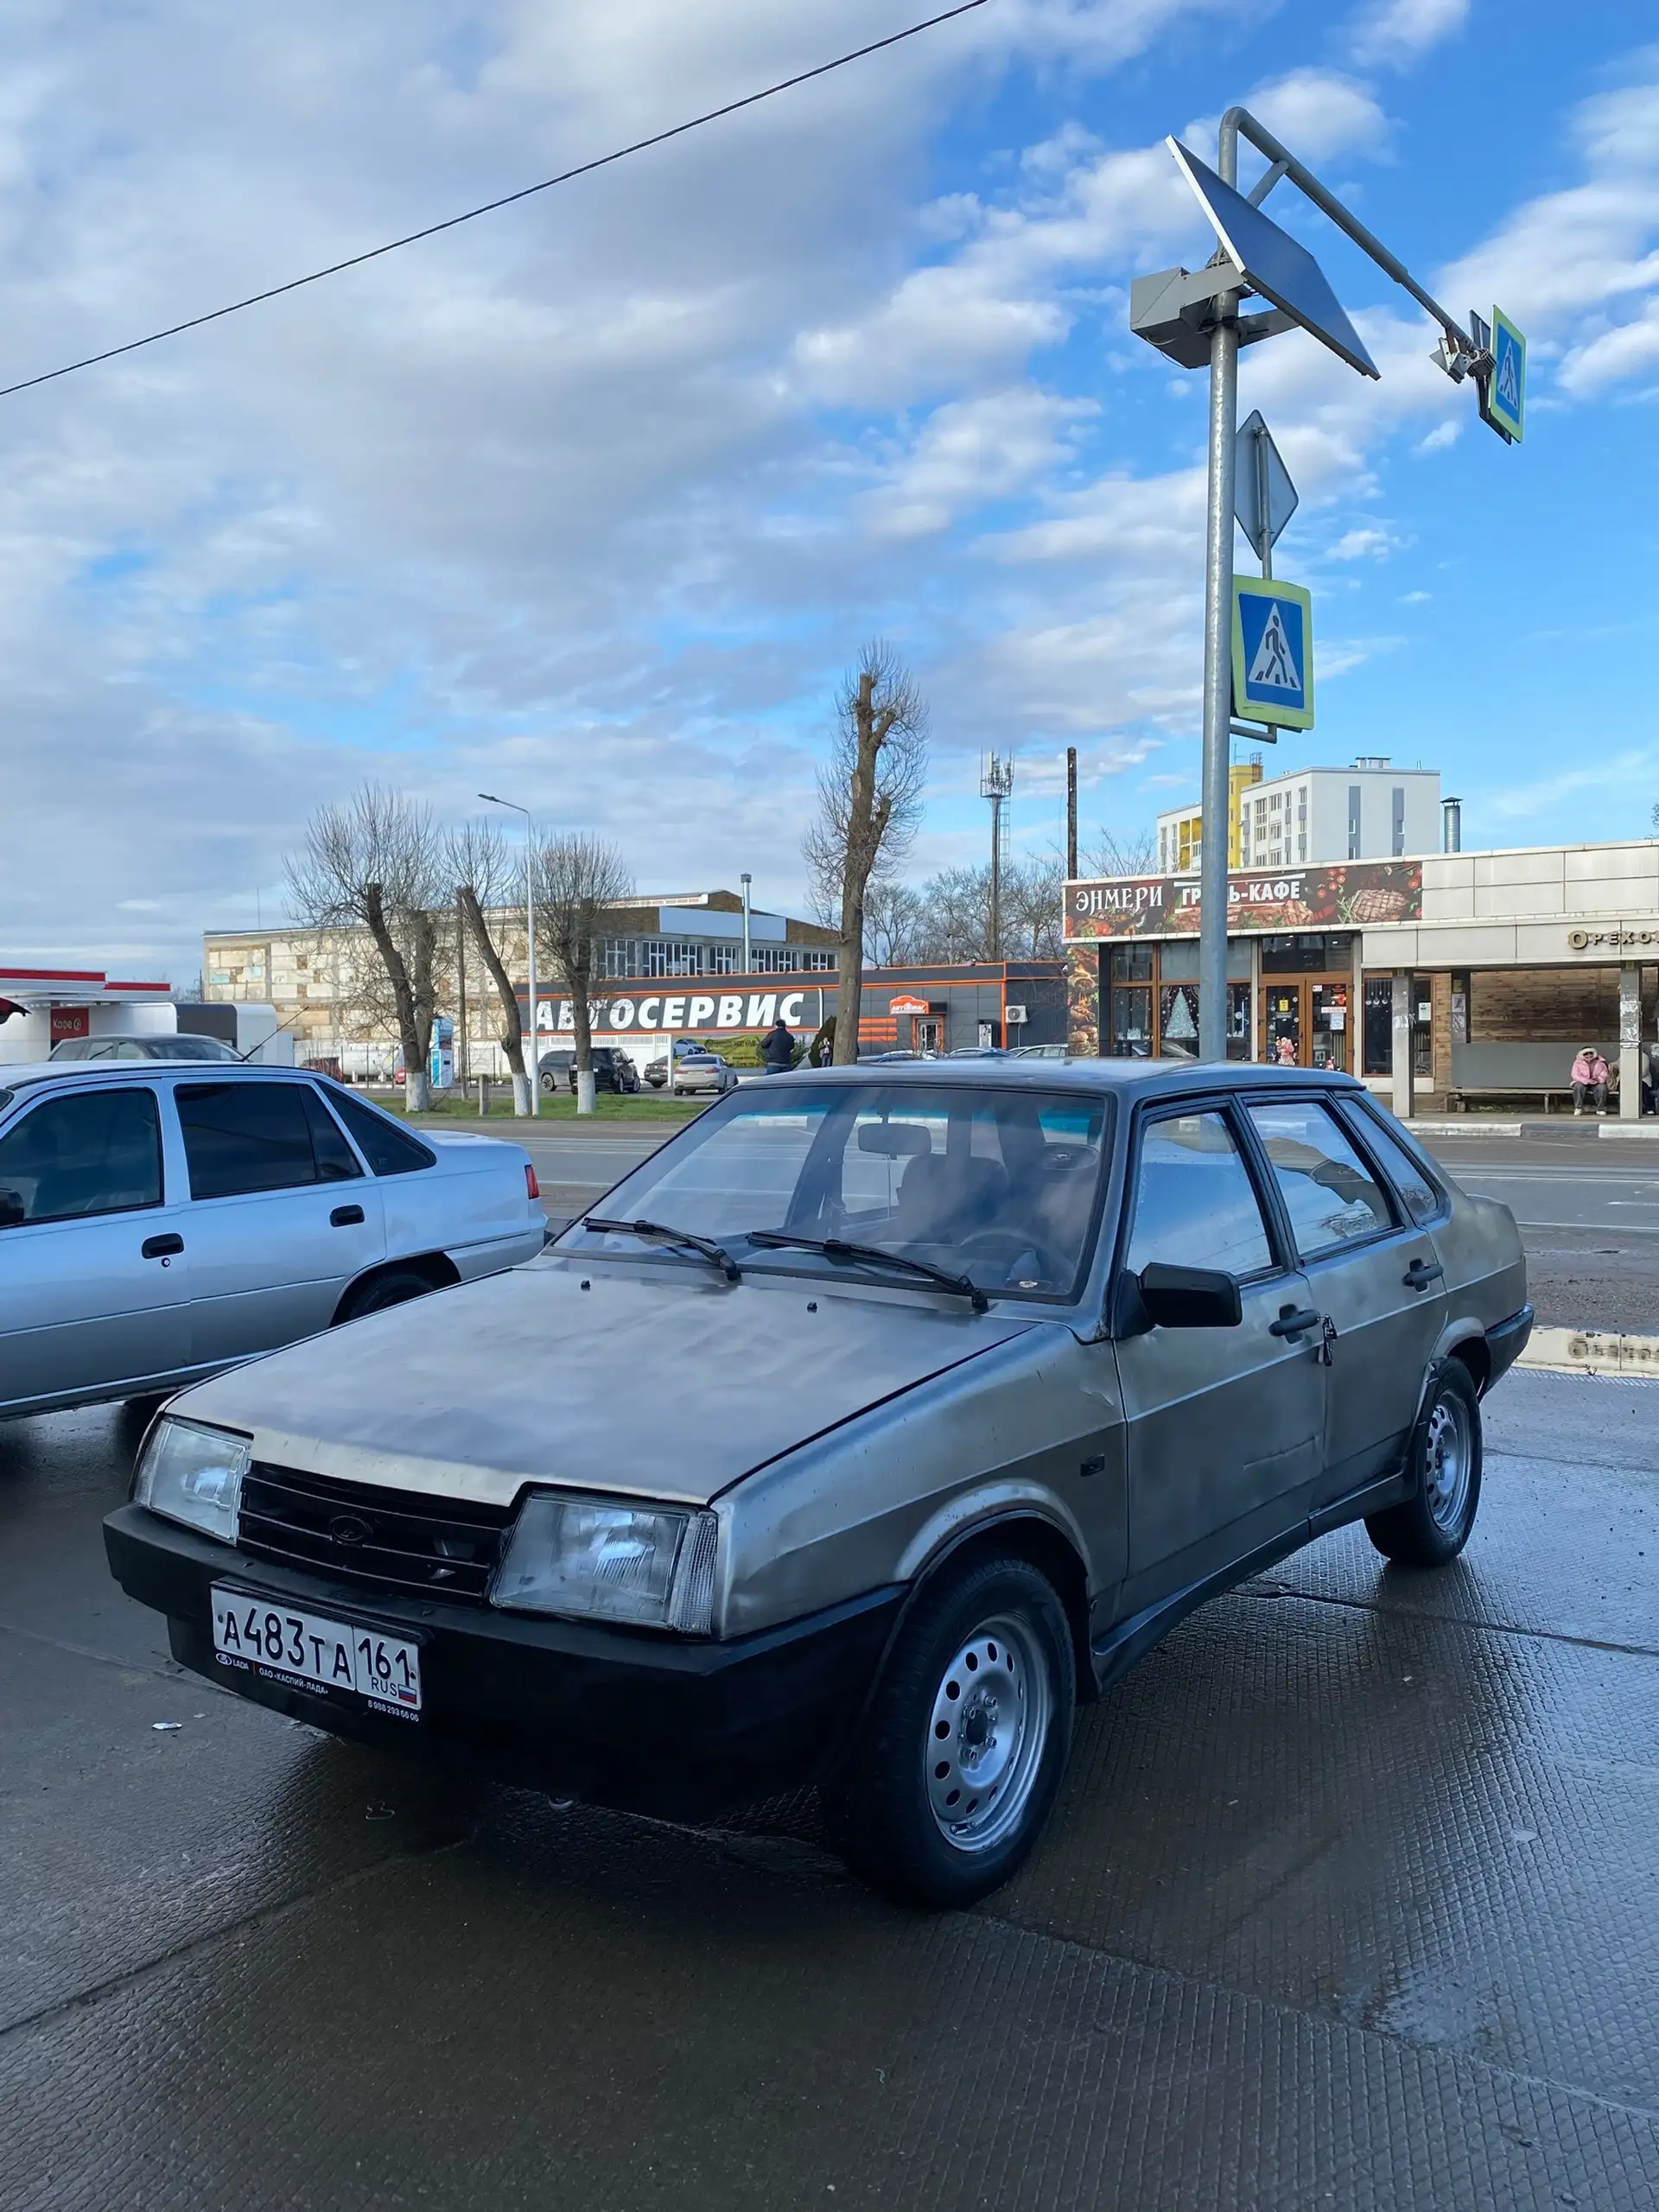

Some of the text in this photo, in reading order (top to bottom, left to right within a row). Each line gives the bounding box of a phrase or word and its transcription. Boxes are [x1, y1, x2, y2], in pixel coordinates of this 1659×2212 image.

[1076, 881, 1300, 915] ЭНМЕРИ ГРЬ-КАФЕ
[529, 993, 804, 1032] АВТОСЕРВИС
[223, 1607, 410, 1688] А483ТА 161
[232, 1659, 250, 1670] LADA
[258, 1667, 274, 1679] ОАО
[371, 1676, 397, 1697] RUS
